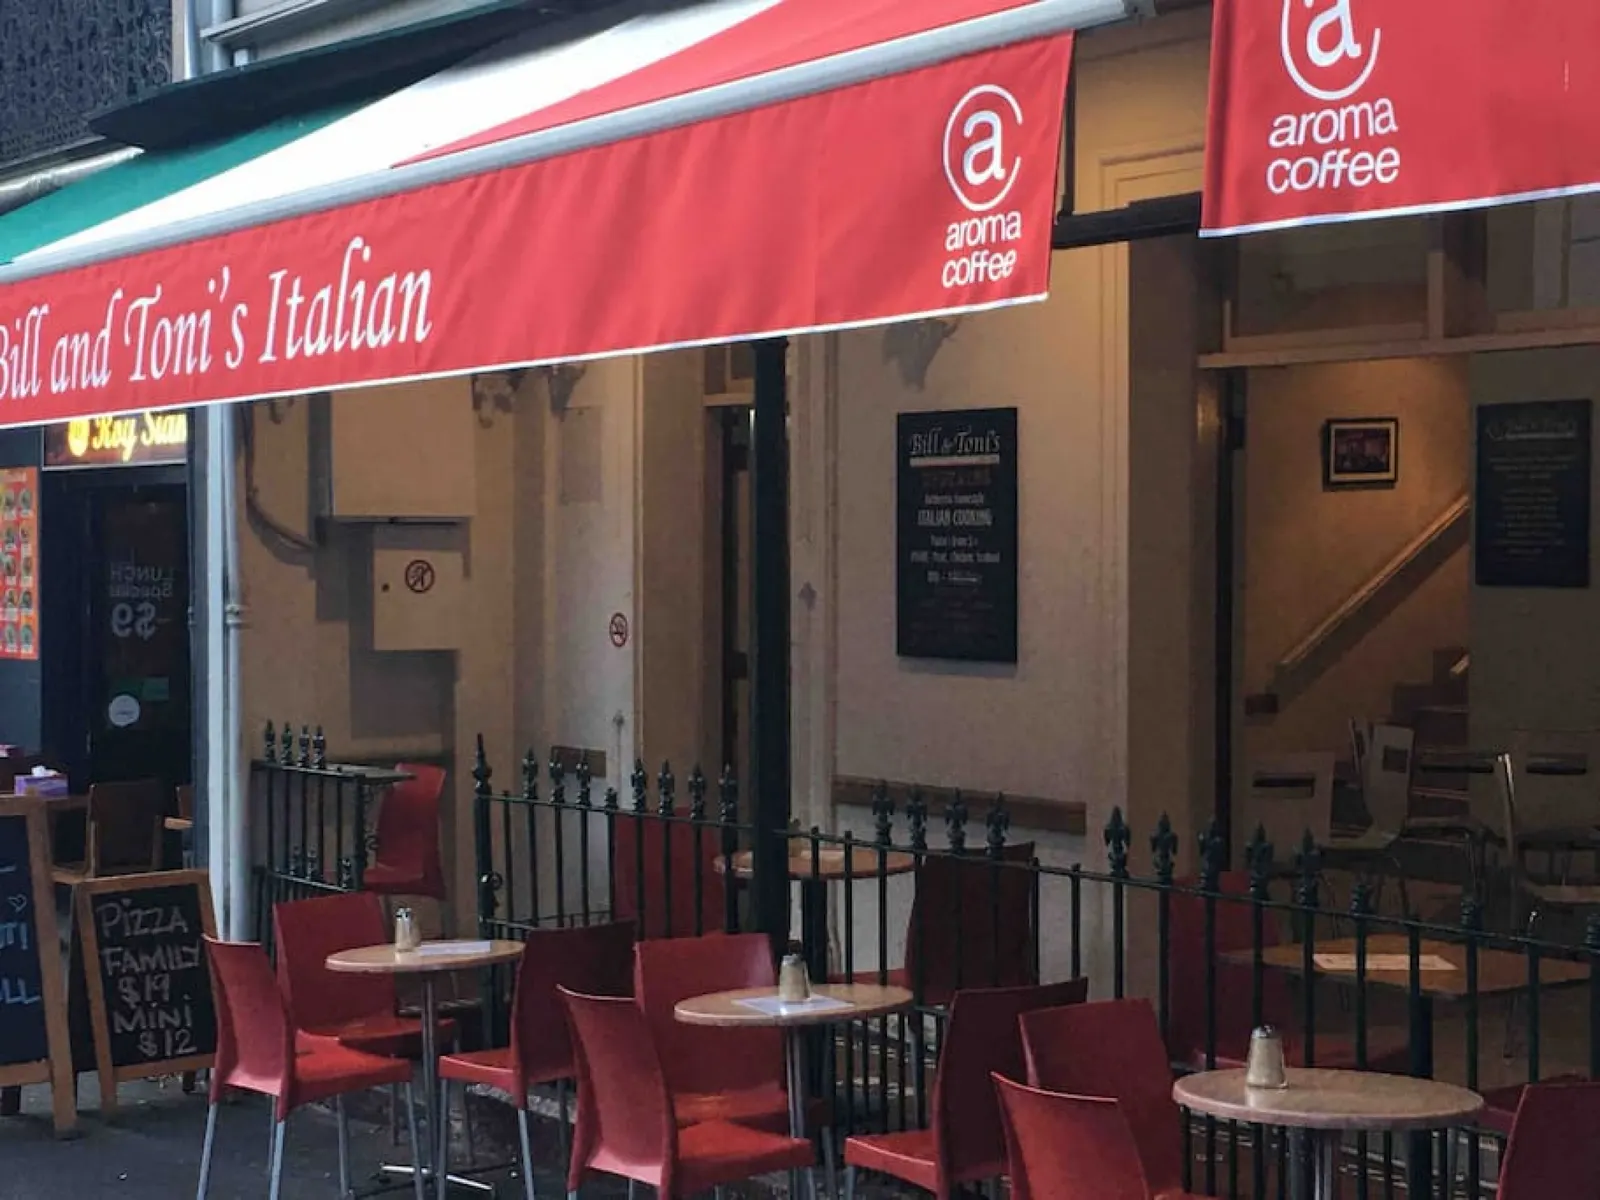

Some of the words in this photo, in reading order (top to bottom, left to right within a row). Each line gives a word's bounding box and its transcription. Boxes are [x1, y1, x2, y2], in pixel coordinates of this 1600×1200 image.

[1268, 98, 1398, 147] aroma
[1266, 147, 1400, 194] coffee
[945, 211, 1021, 251] aroma
[942, 249, 1017, 288] coffee
[50, 288, 123, 394] and
[124, 266, 248, 381] Toni's
[259, 236, 432, 364] Italian
[909, 426, 942, 455] Bill
[101, 939, 200, 976] FAMILY
[117, 973, 170, 1008] $19
[138, 1029, 198, 1057] $12
